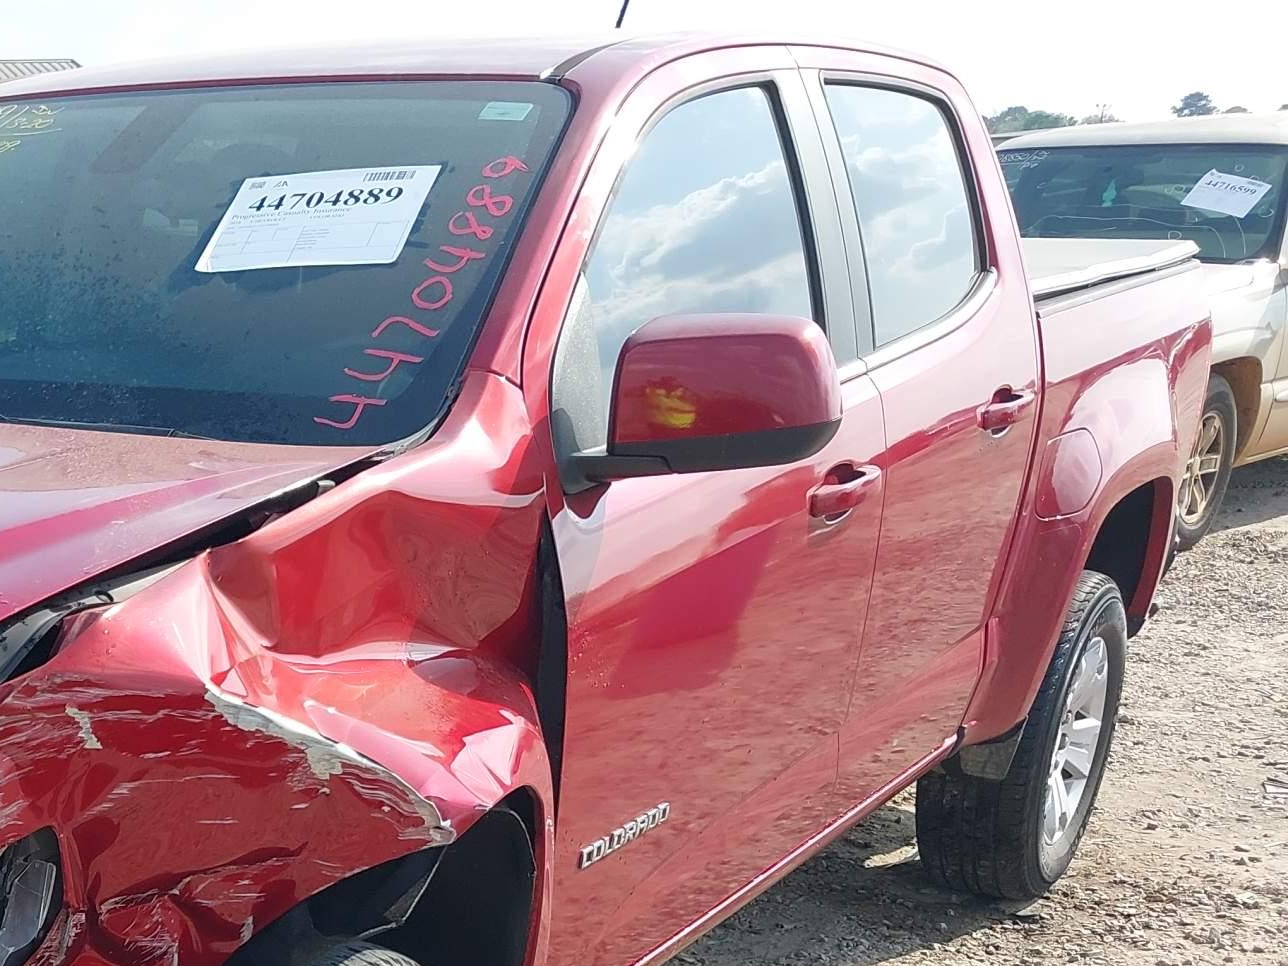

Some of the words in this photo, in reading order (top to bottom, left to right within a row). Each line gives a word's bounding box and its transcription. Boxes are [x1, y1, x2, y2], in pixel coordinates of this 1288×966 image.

[248, 187, 404, 212] 44704889
[313, 155, 529, 430] 44704889
[580, 802, 670, 870] COLORADO
